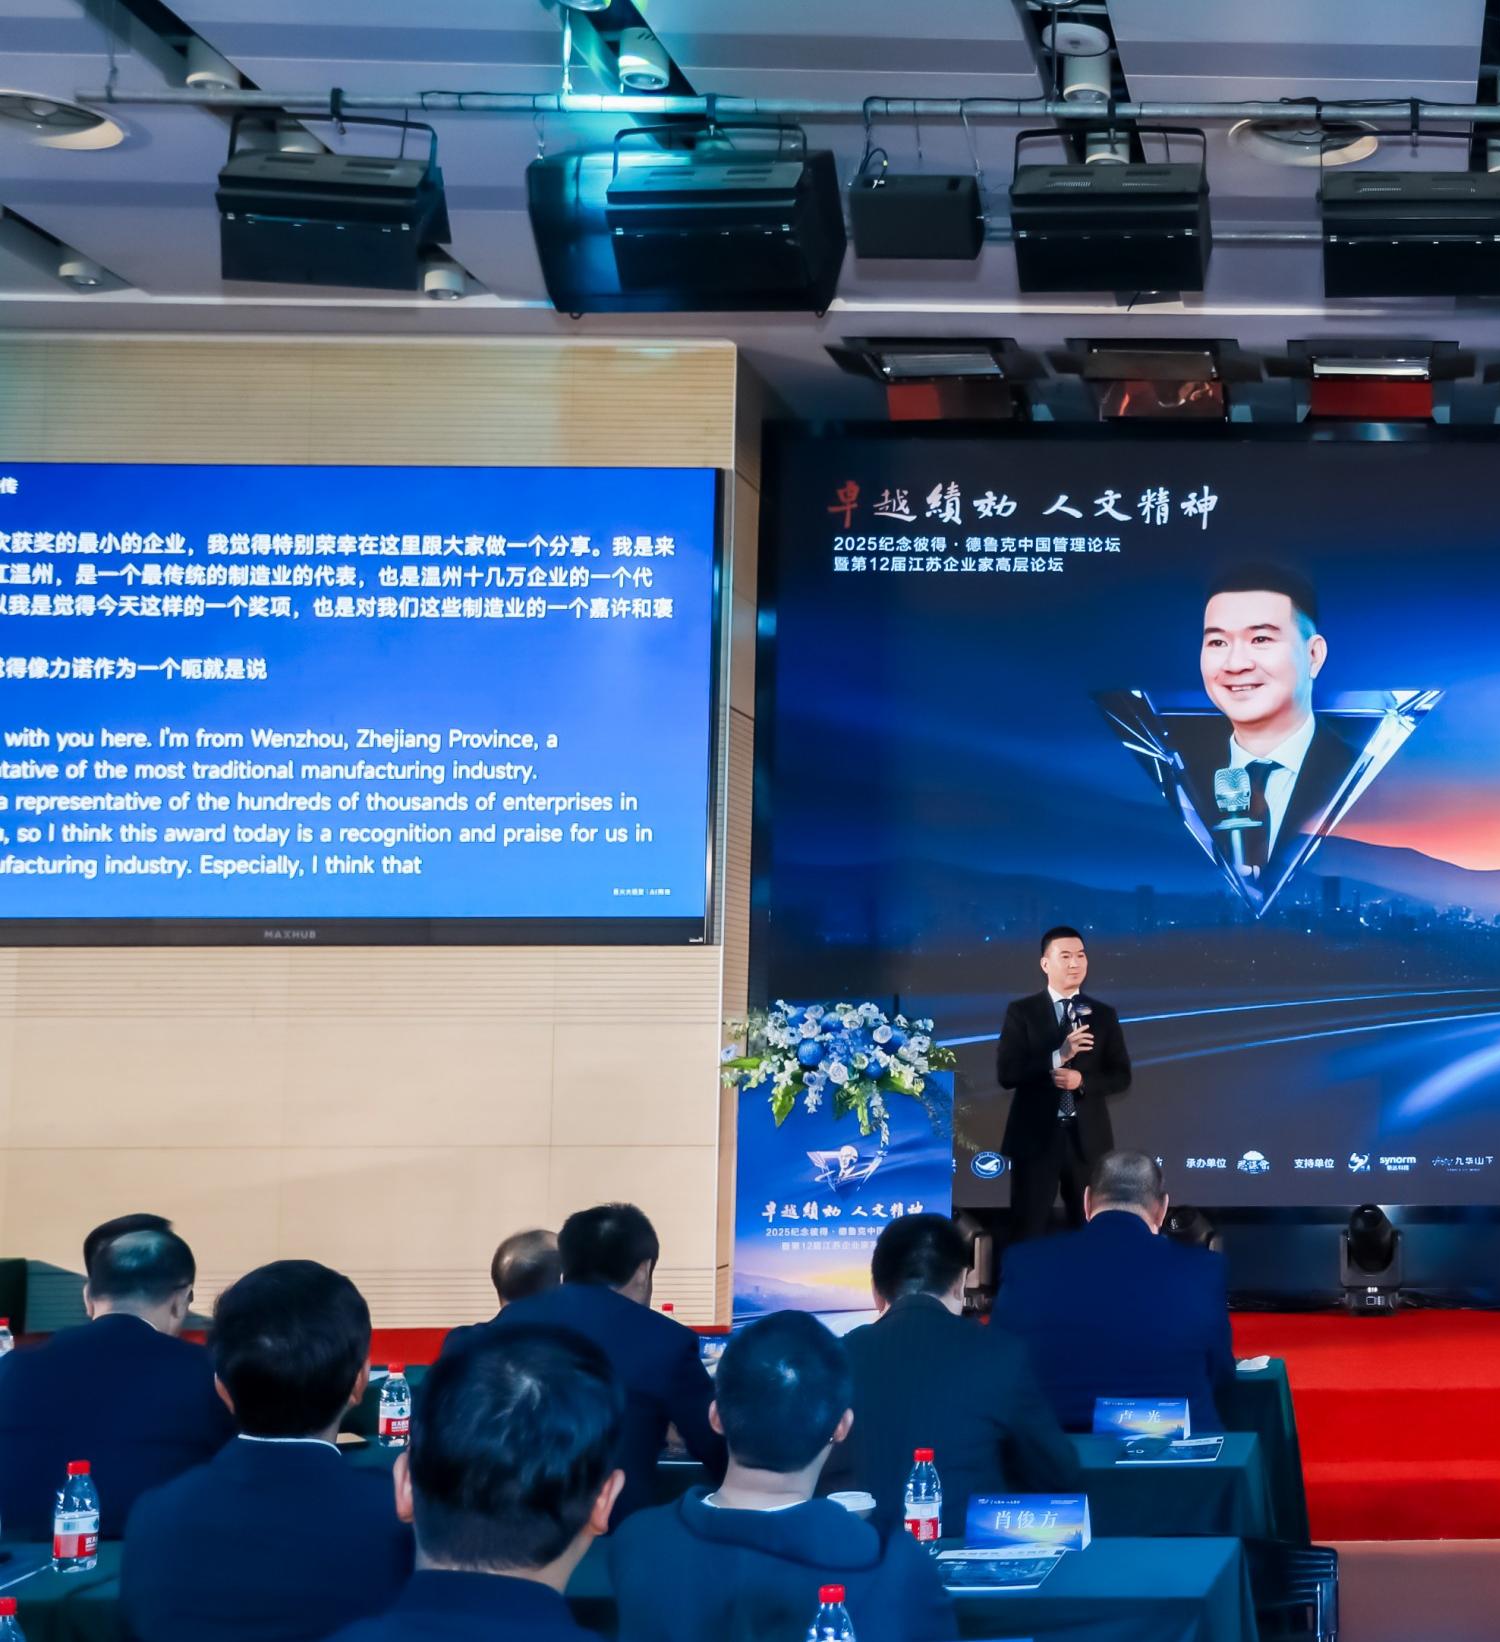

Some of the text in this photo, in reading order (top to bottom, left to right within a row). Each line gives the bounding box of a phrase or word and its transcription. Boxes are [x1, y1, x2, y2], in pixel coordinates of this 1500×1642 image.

[833, 555, 1064, 573] 暨第12届江苏企业家高层论坛
[3, 725, 558, 754] with you here. I'm from Wenzhou, Zhejiang Province, a
[0, 758, 537, 785] tative of the most traditional manufacturing industry.
[14, 791, 162, 816] representative
[168, 790, 191, 811] of
[196, 791, 231, 811] the
[236, 791, 332, 811] hundreds
[337, 791, 360, 811] of
[365, 791, 469, 811] thousands
[475, 791, 497, 811] of
[502, 791, 613, 816] enterprises
[620, 791, 638, 811] in
[16, 827, 42, 843] so
[61, 822, 113, 843] think
[119, 822, 158, 843] this
[163, 823, 226, 843] award
[232, 823, 291, 848] today
[296, 823, 313, 843] is
[319, 827, 332, 843] a
[339, 823, 452, 848] recognition
[458, 823, 496, 843] and
[503, 823, 563, 848] praise
[569, 822, 599, 843] for
[605, 827, 629, 843] us
[635, 823, 653, 842] in
[104, 854, 193, 879] industry.
[199, 854, 305, 880] Especially,
[324, 854, 375, 875] think
[381, 854, 423, 875] that
[263, 929, 317, 940] MAXHUB
[1185, 1157, 1227, 1169] 承办单位
[1293, 1157, 1335, 1169] 支持单位
[1379, 1155, 1417, 1165] synorm
[994, 1509, 1059, 1530] 肖俊方
